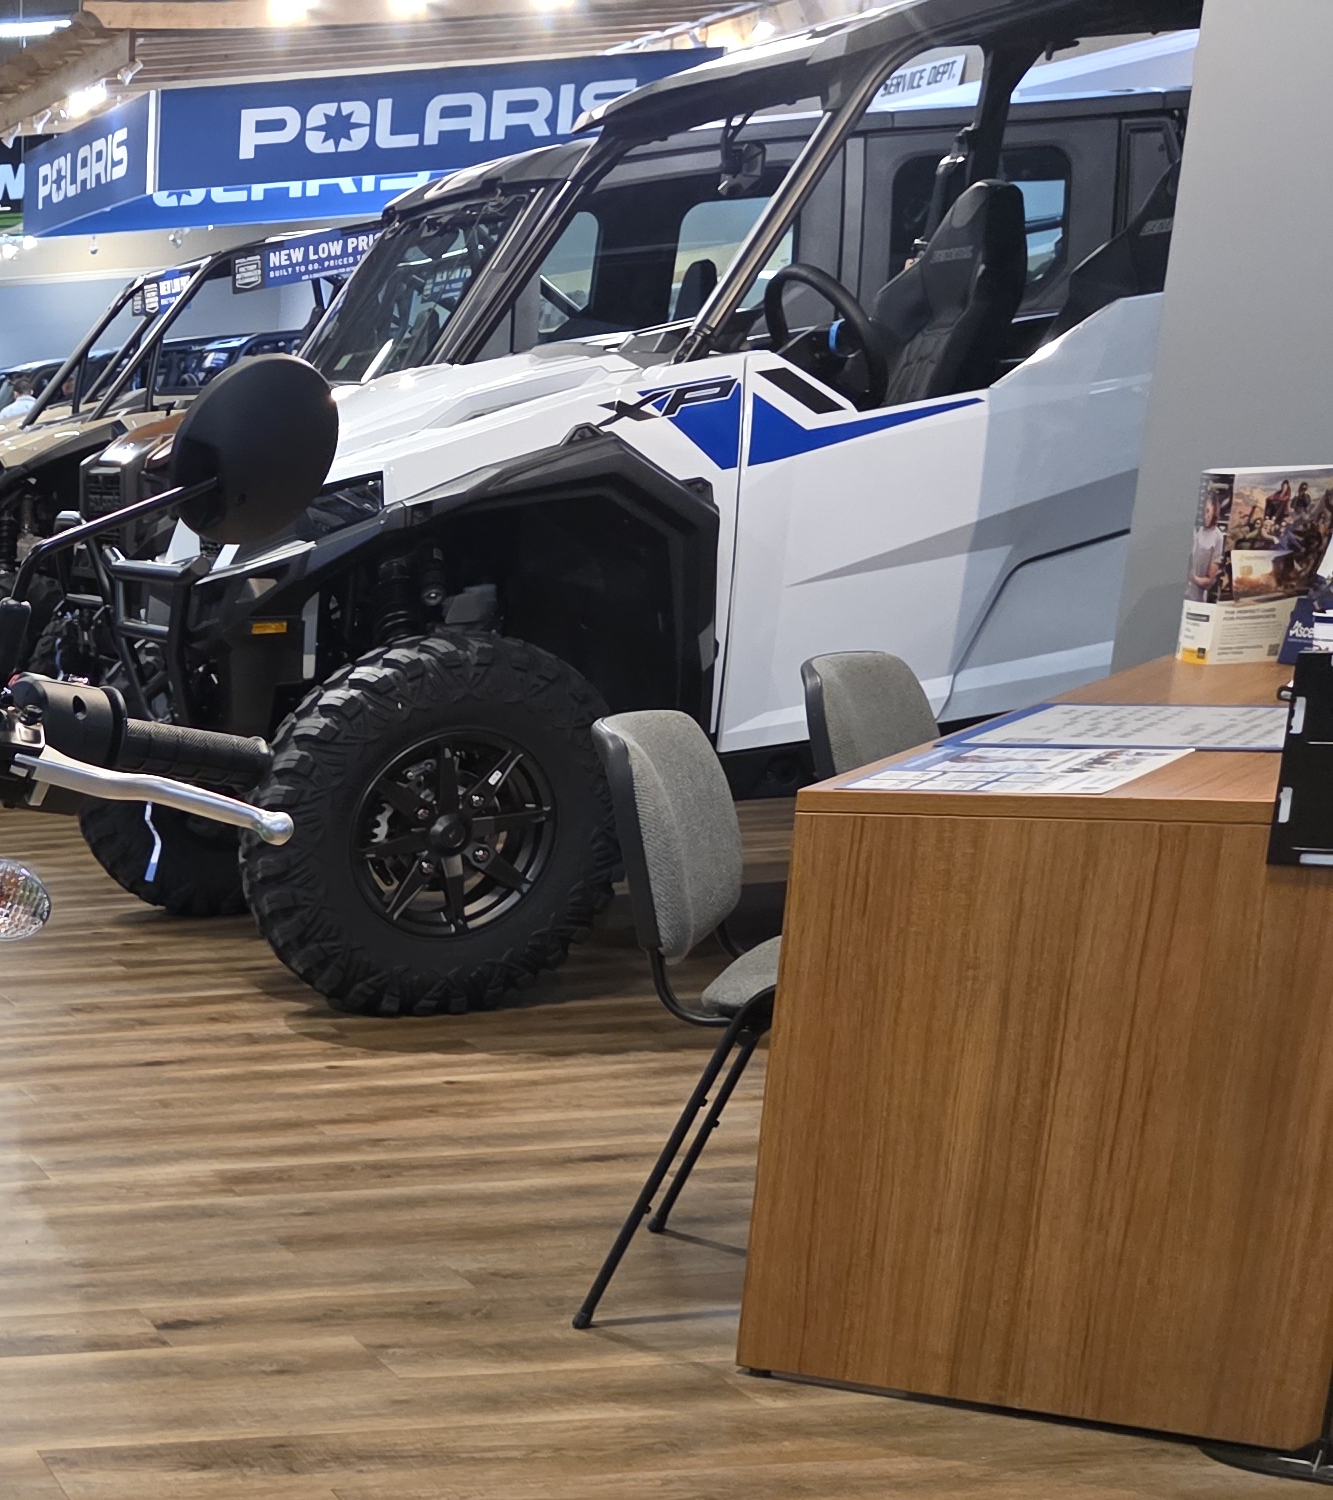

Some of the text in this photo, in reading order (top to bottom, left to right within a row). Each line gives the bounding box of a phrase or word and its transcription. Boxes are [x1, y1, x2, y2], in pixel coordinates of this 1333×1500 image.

[38, 126, 129, 210] POLARIS
[269, 247, 305, 267] NEW
[308, 239, 343, 260] LOW
[269, 267, 293, 278] BUILT
[295, 264, 306, 272] TO
[324, 256, 354, 268] PRICED
[596, 377, 739, 428] XP
